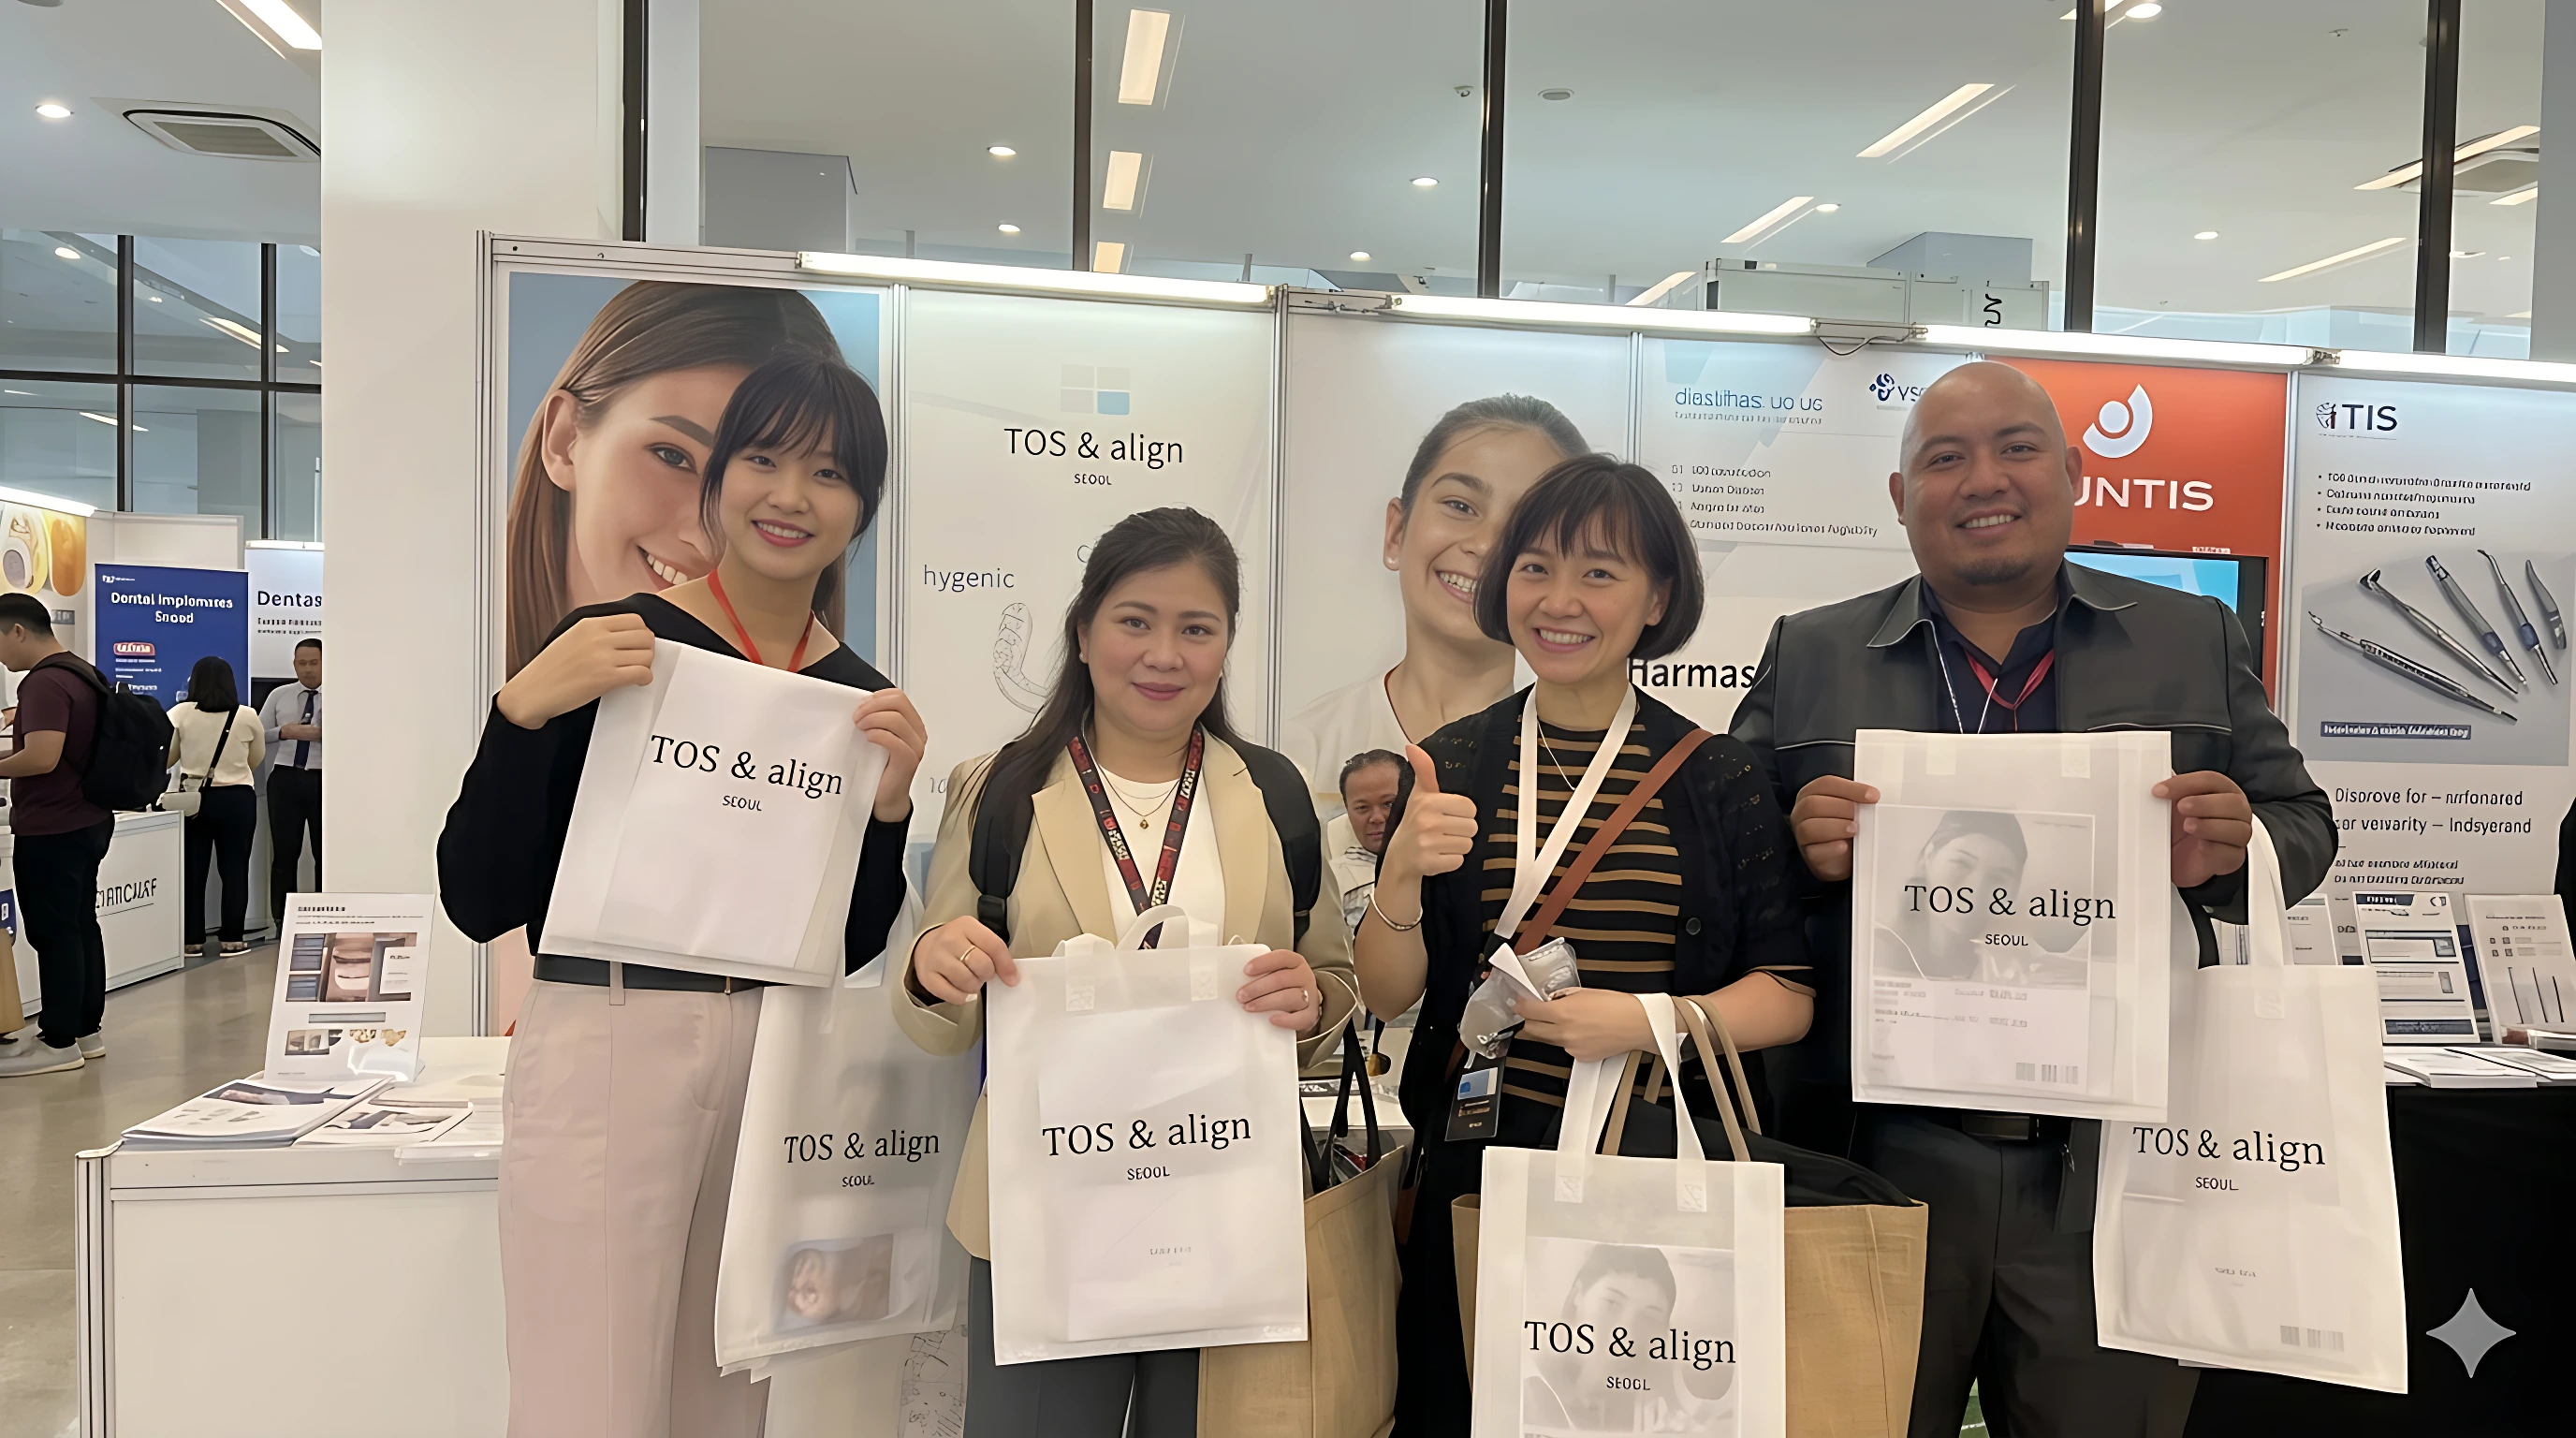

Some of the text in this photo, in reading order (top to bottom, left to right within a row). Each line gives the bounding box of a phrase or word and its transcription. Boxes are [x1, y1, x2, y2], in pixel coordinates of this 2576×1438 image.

[1003, 428, 1182, 470] TOS & align
[924, 564, 1015, 593] hygenic
[651, 734, 842, 800] TOS & align
[2406, 787, 2427, 804] for
[1904, 885, 2116, 927] TOS & align
[783, 1129, 940, 1164] TOS & align
[1042, 1113, 1251, 1156] TOS & align
[2132, 1126, 2326, 1172] TOS & align
[2195, 1176, 2239, 1191] SEOUL
[1524, 1320, 1736, 1372] TOS & align
